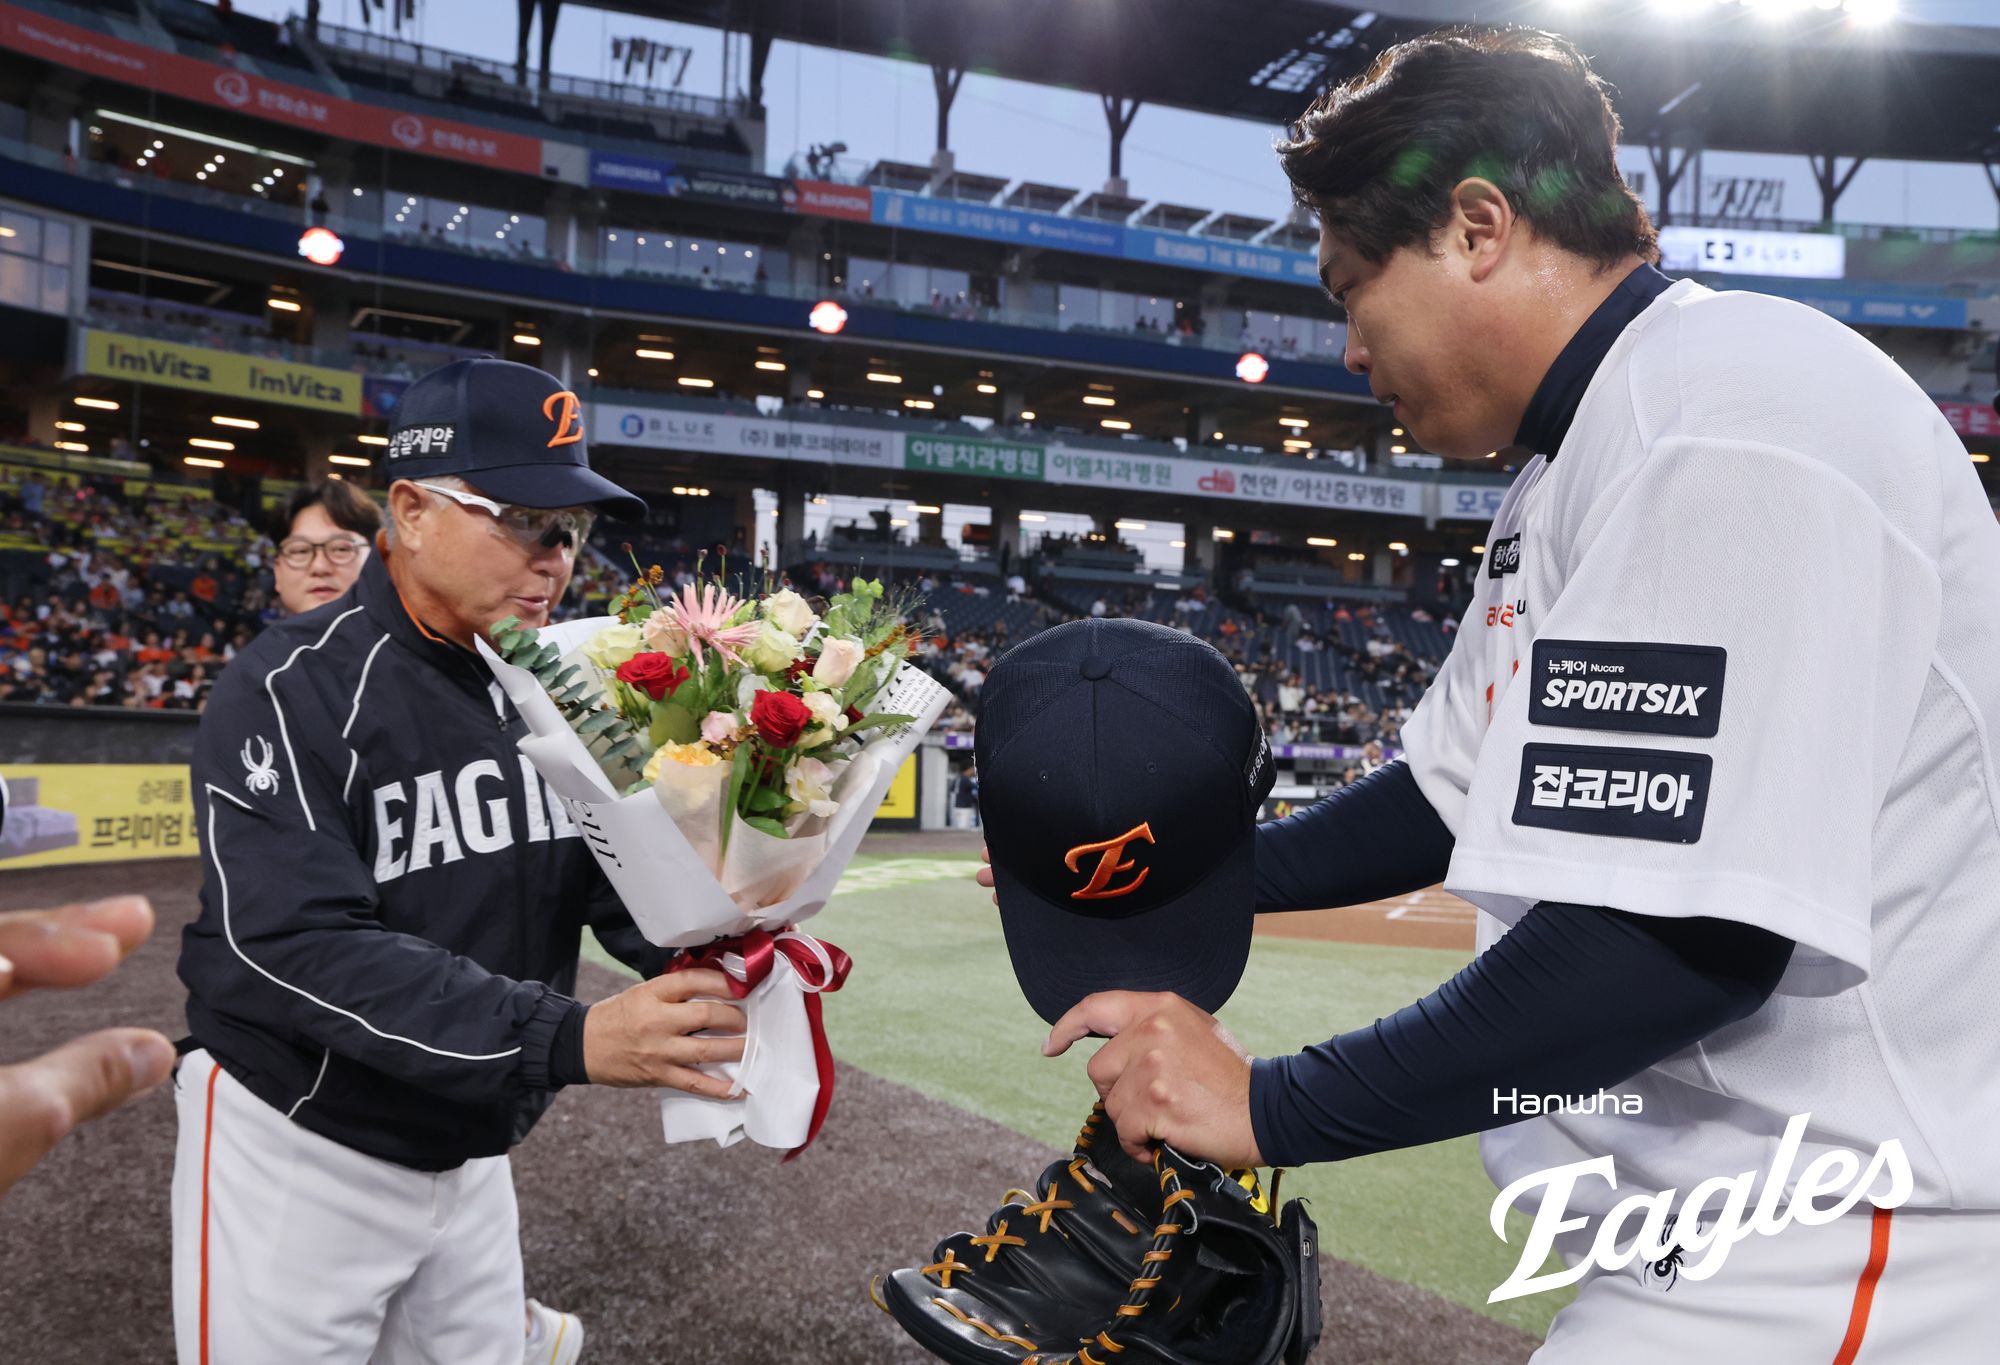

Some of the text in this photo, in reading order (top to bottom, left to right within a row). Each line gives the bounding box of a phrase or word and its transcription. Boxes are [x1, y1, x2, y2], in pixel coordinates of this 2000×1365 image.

[388, 425, 455, 460] 삼일제약
[1548, 659, 1625, 675] 뉴케어 Nucare
[1541, 678, 1708, 717] SPORTSIX
[1531, 764, 1694, 818] 잡코리아
[91, 813, 183, 849] 프리미엄
